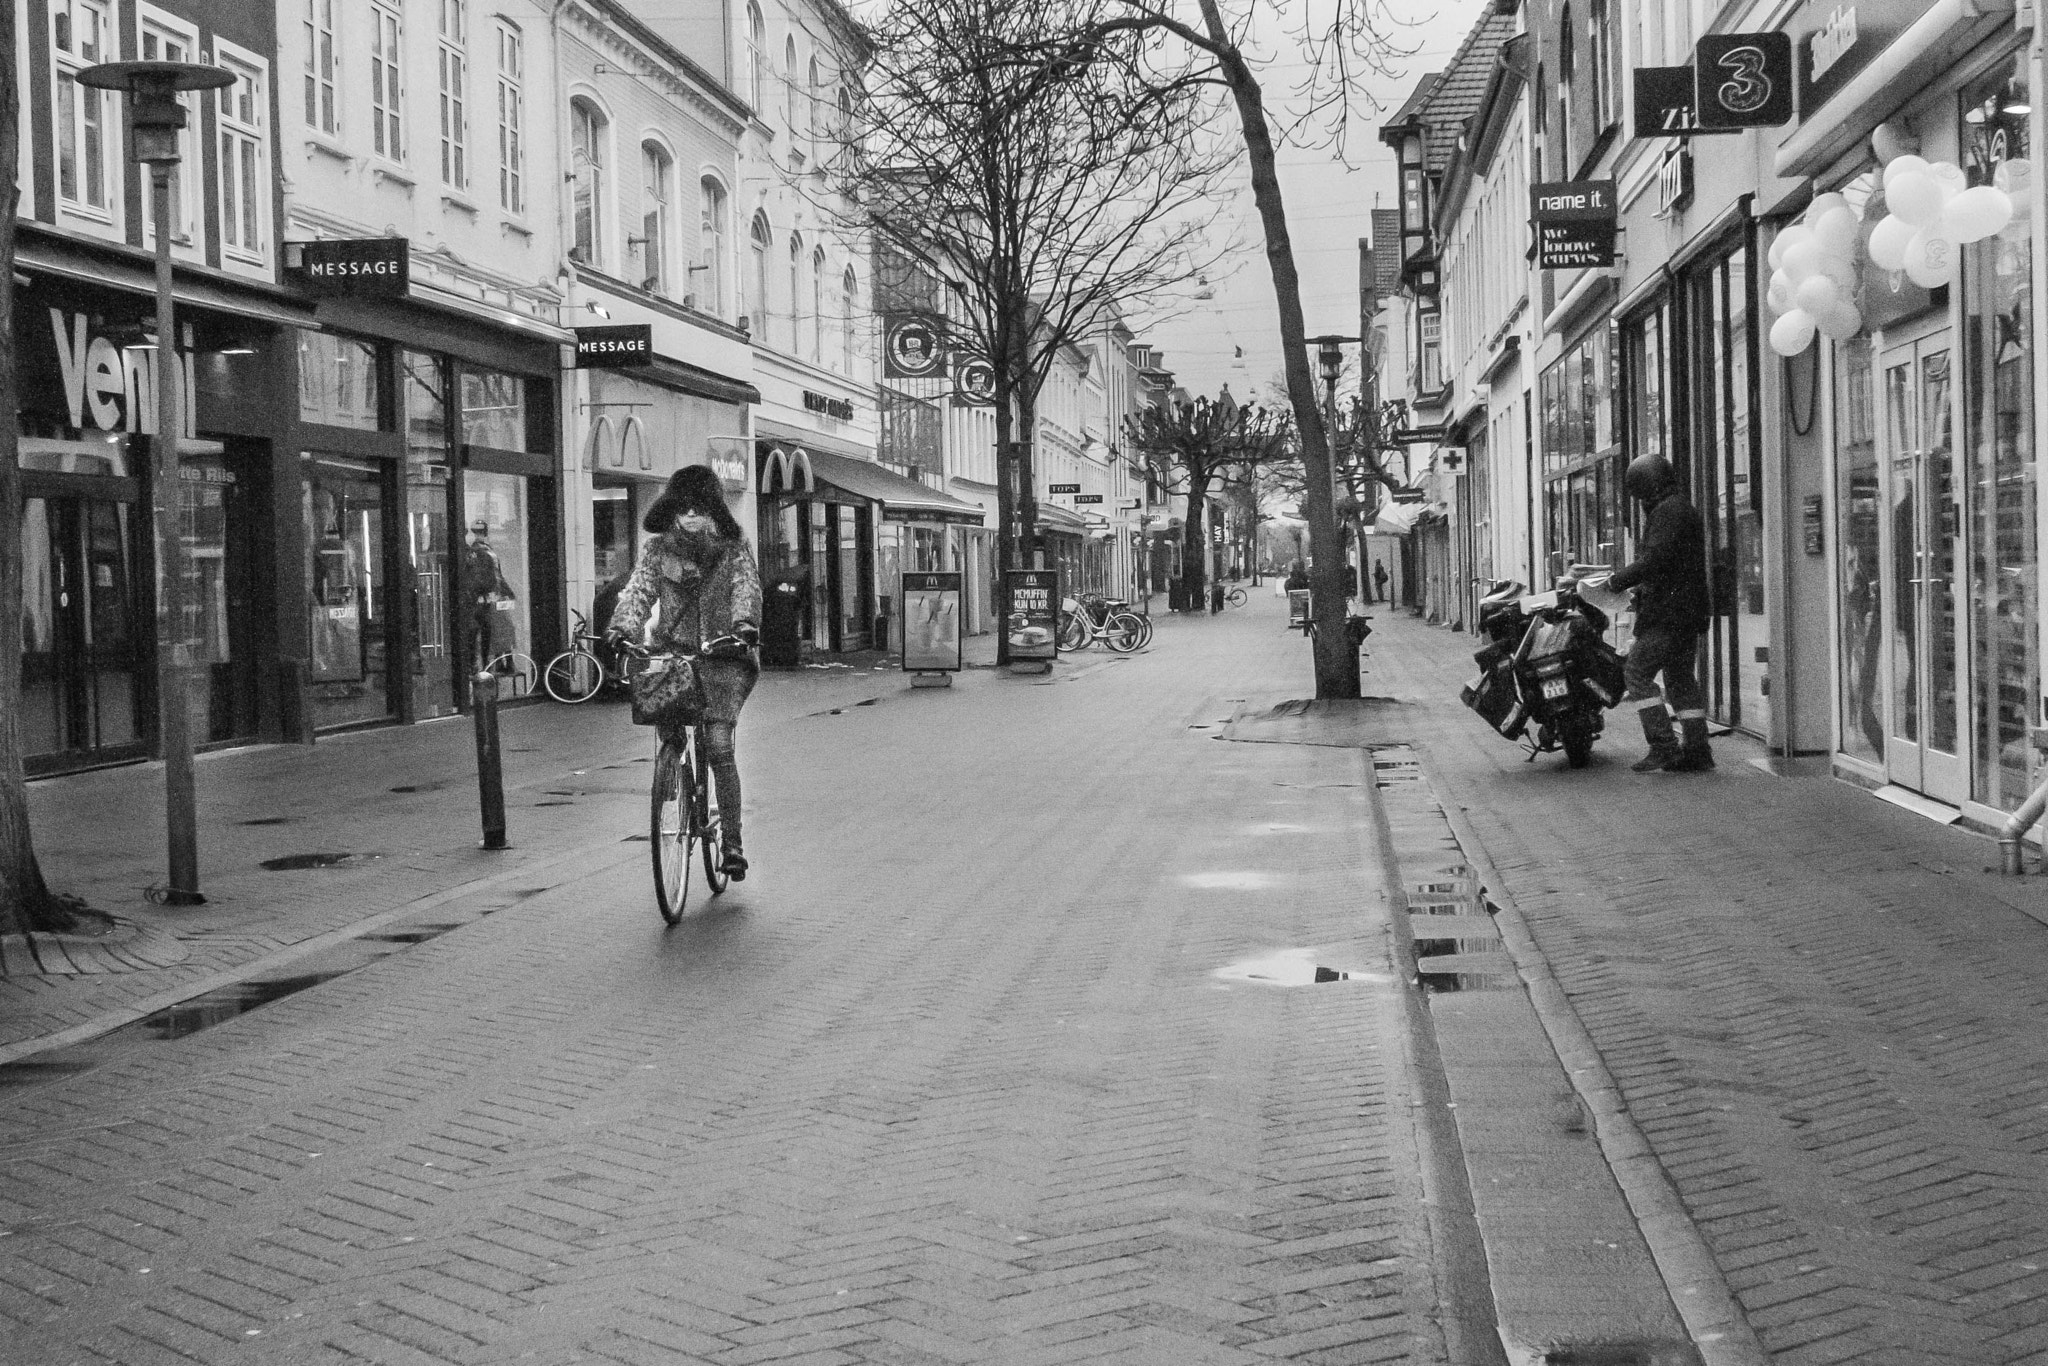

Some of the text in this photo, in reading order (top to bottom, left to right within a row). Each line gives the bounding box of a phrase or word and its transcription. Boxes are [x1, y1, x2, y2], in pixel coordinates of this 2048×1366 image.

[1718, 46, 1772, 112] 3
[1539, 194, 1585, 210] name
[1544, 228, 1567, 239] we
[310, 261, 399, 276] MESSAGE
[578, 340, 646, 353] MESSAGE
[1214, 525, 1222, 542] HAY
[1014, 589, 1048, 599] MCMUFFIN
[1014, 599, 1028, 609] KUN
